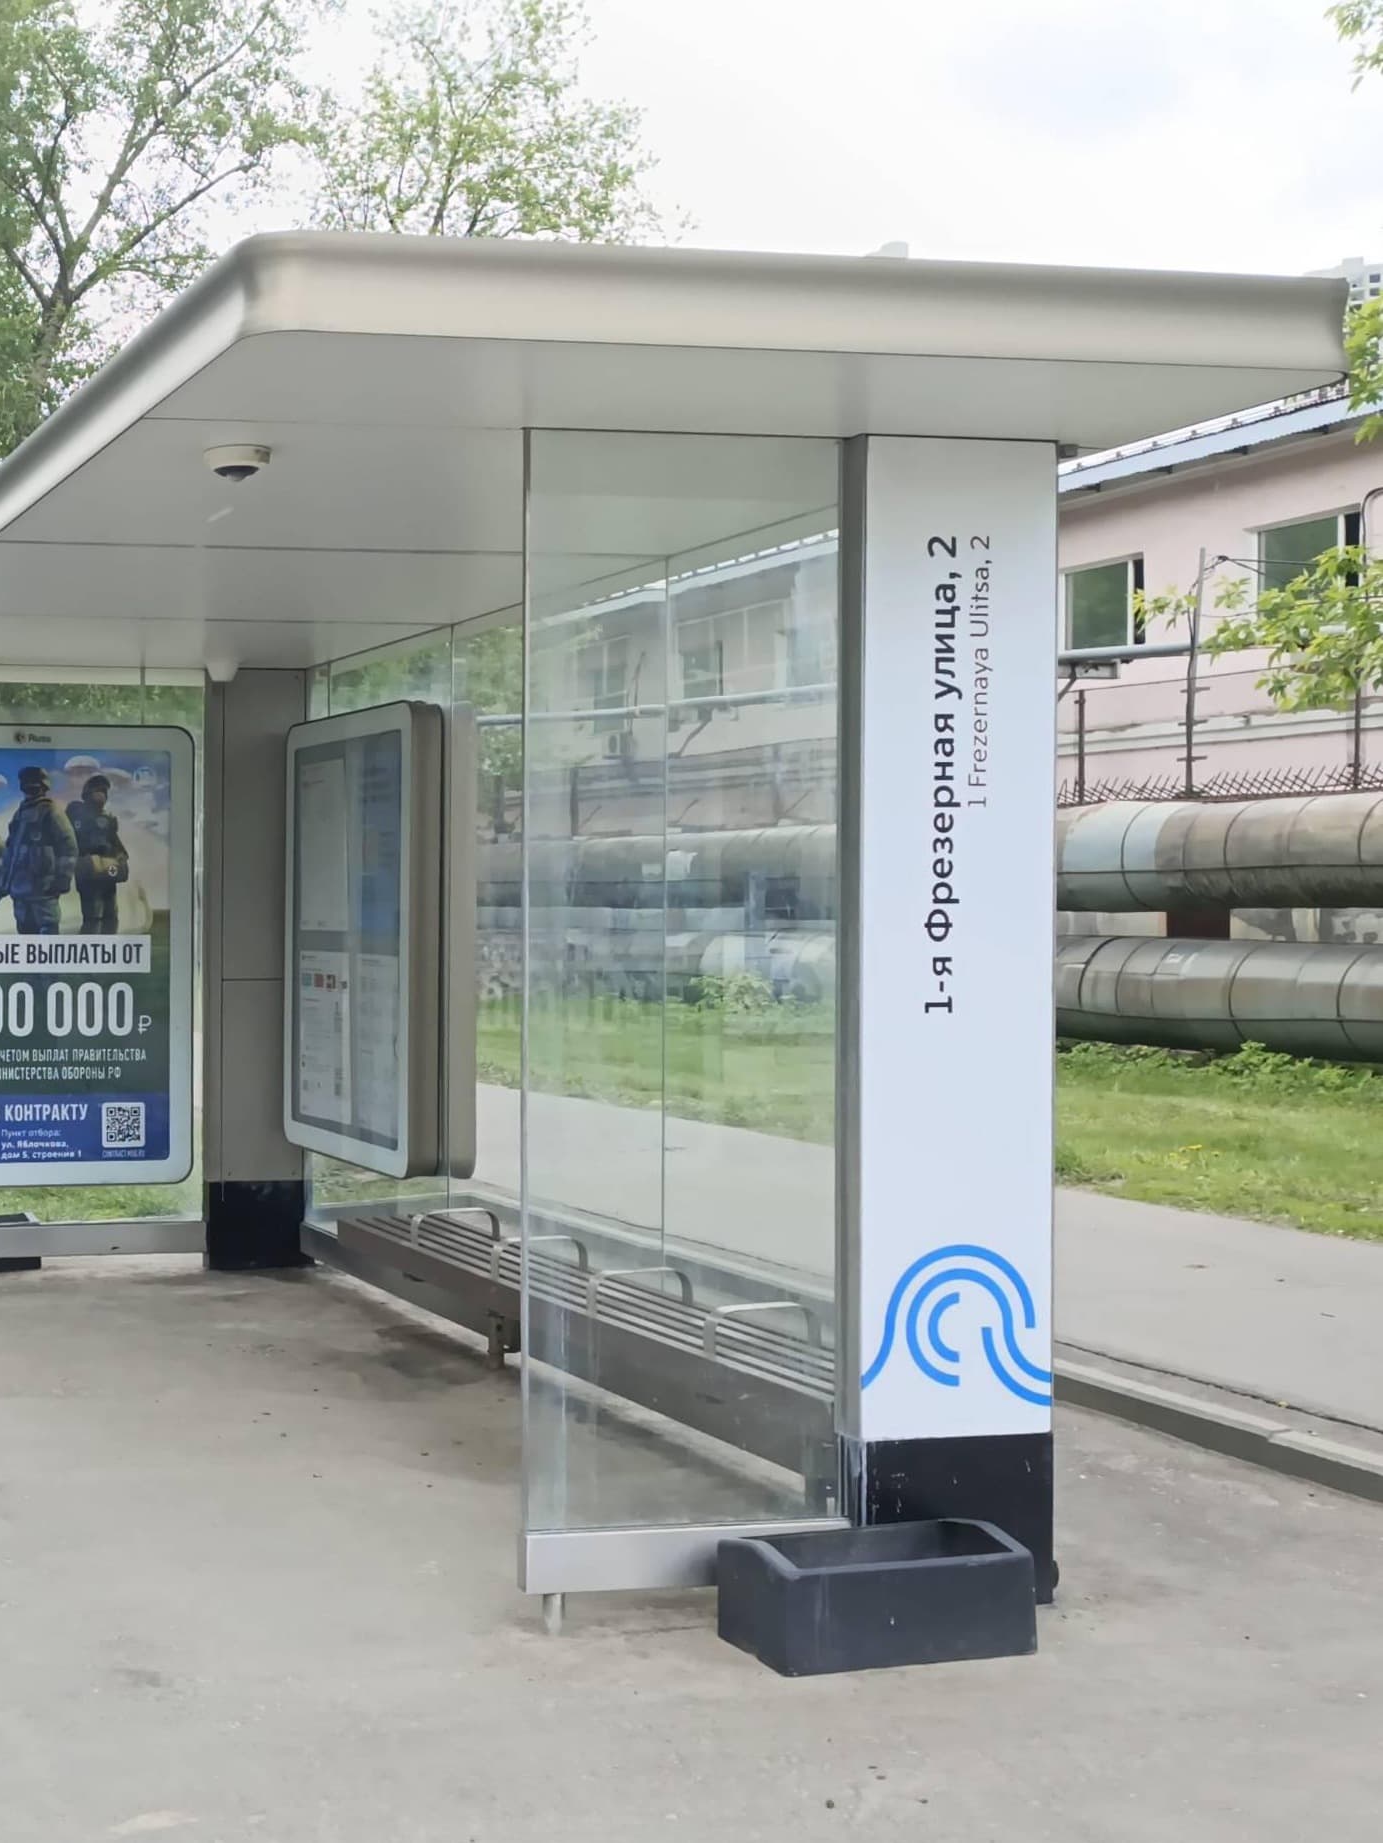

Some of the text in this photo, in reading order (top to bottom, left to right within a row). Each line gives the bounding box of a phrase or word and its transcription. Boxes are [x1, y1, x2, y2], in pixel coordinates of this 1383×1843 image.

[967, 535, 993, 808] 1 Frezernaya Ulitsa, 2
[924, 535, 963, 1014] 1-я Фрезерная улица, 2
[26, 943, 116, 964] ВЫПЛАТЫ
[122, 943, 143, 964] ОТ
[32, 1049, 69, 1062] ВЫПЛАТ
[72, 1048, 147, 1062] ПРАВИТЕЛЬСТВА
[61, 1066, 105, 1080] ОБОРОНЫ
[108, 1066, 122, 1079] РФ
[5, 1103, 88, 1122] КОНТРАКТУ
[1, 1129, 25, 1139] Пункт
